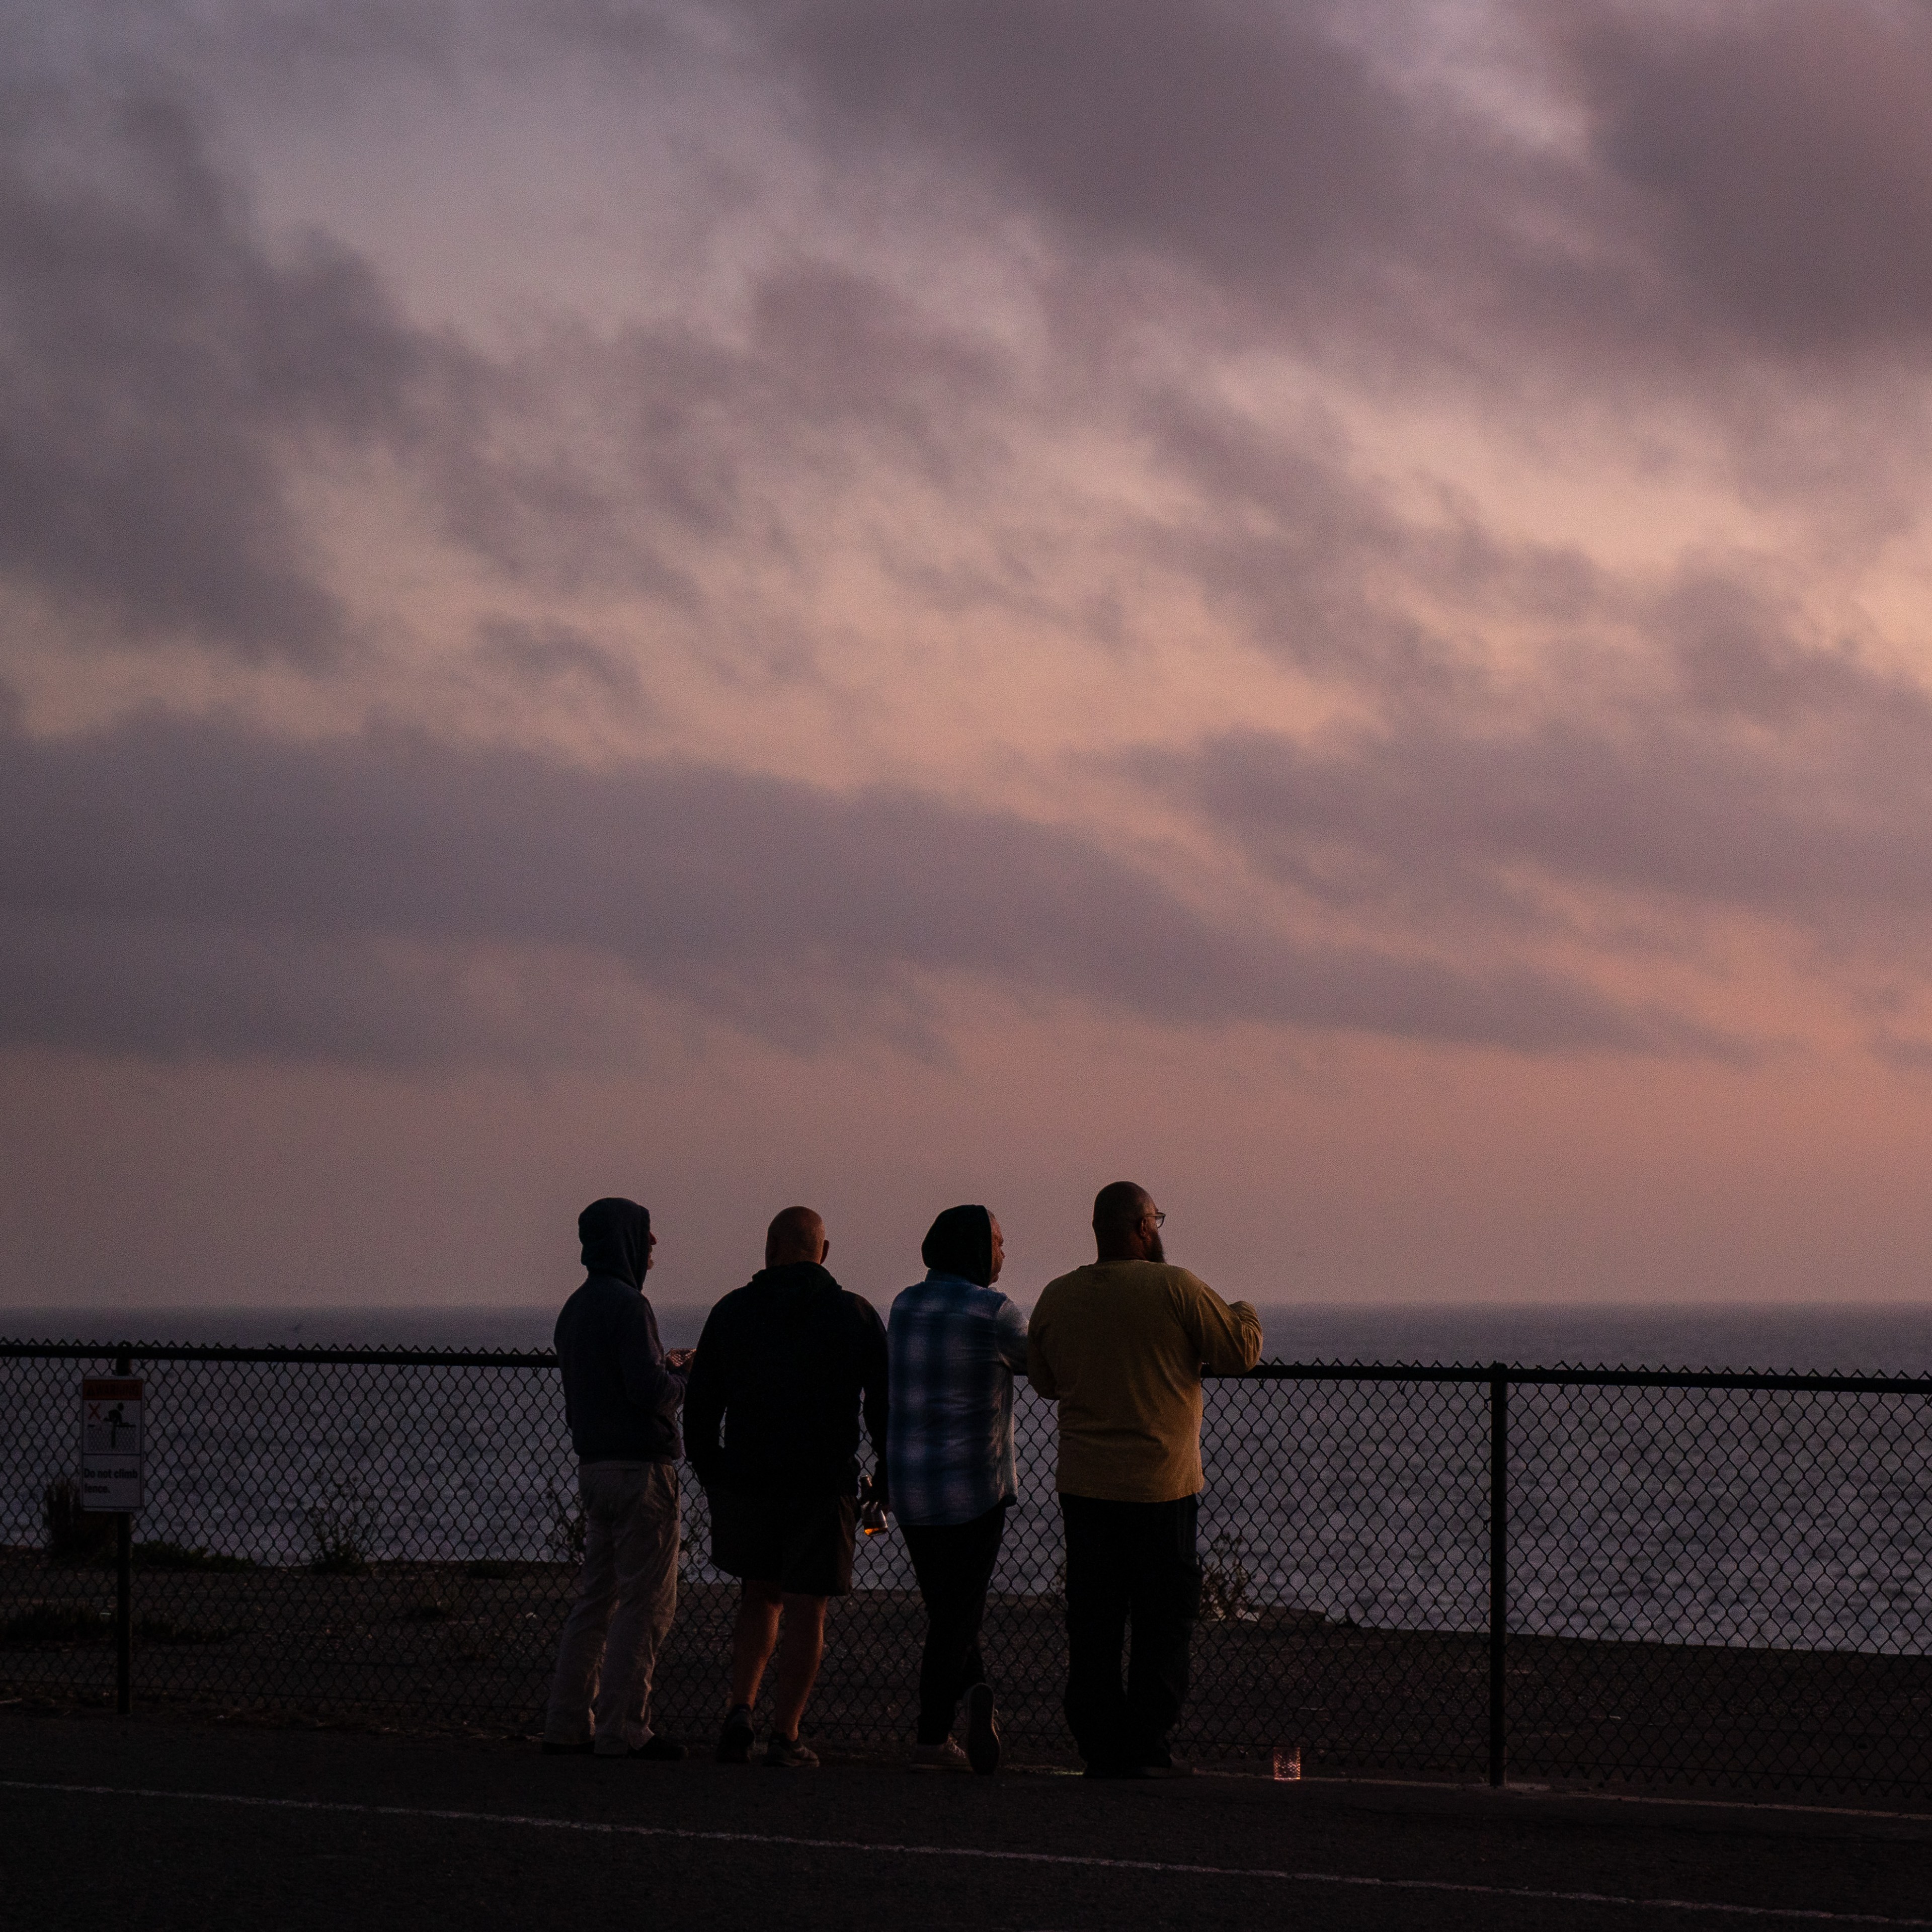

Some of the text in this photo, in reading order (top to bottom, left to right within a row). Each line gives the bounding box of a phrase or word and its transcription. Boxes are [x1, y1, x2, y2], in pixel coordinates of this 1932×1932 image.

[97, 1384, 139, 1396] WARNING
[85, 1468, 138, 1479] Do not climb
[85, 1484, 110, 1493] fence.
